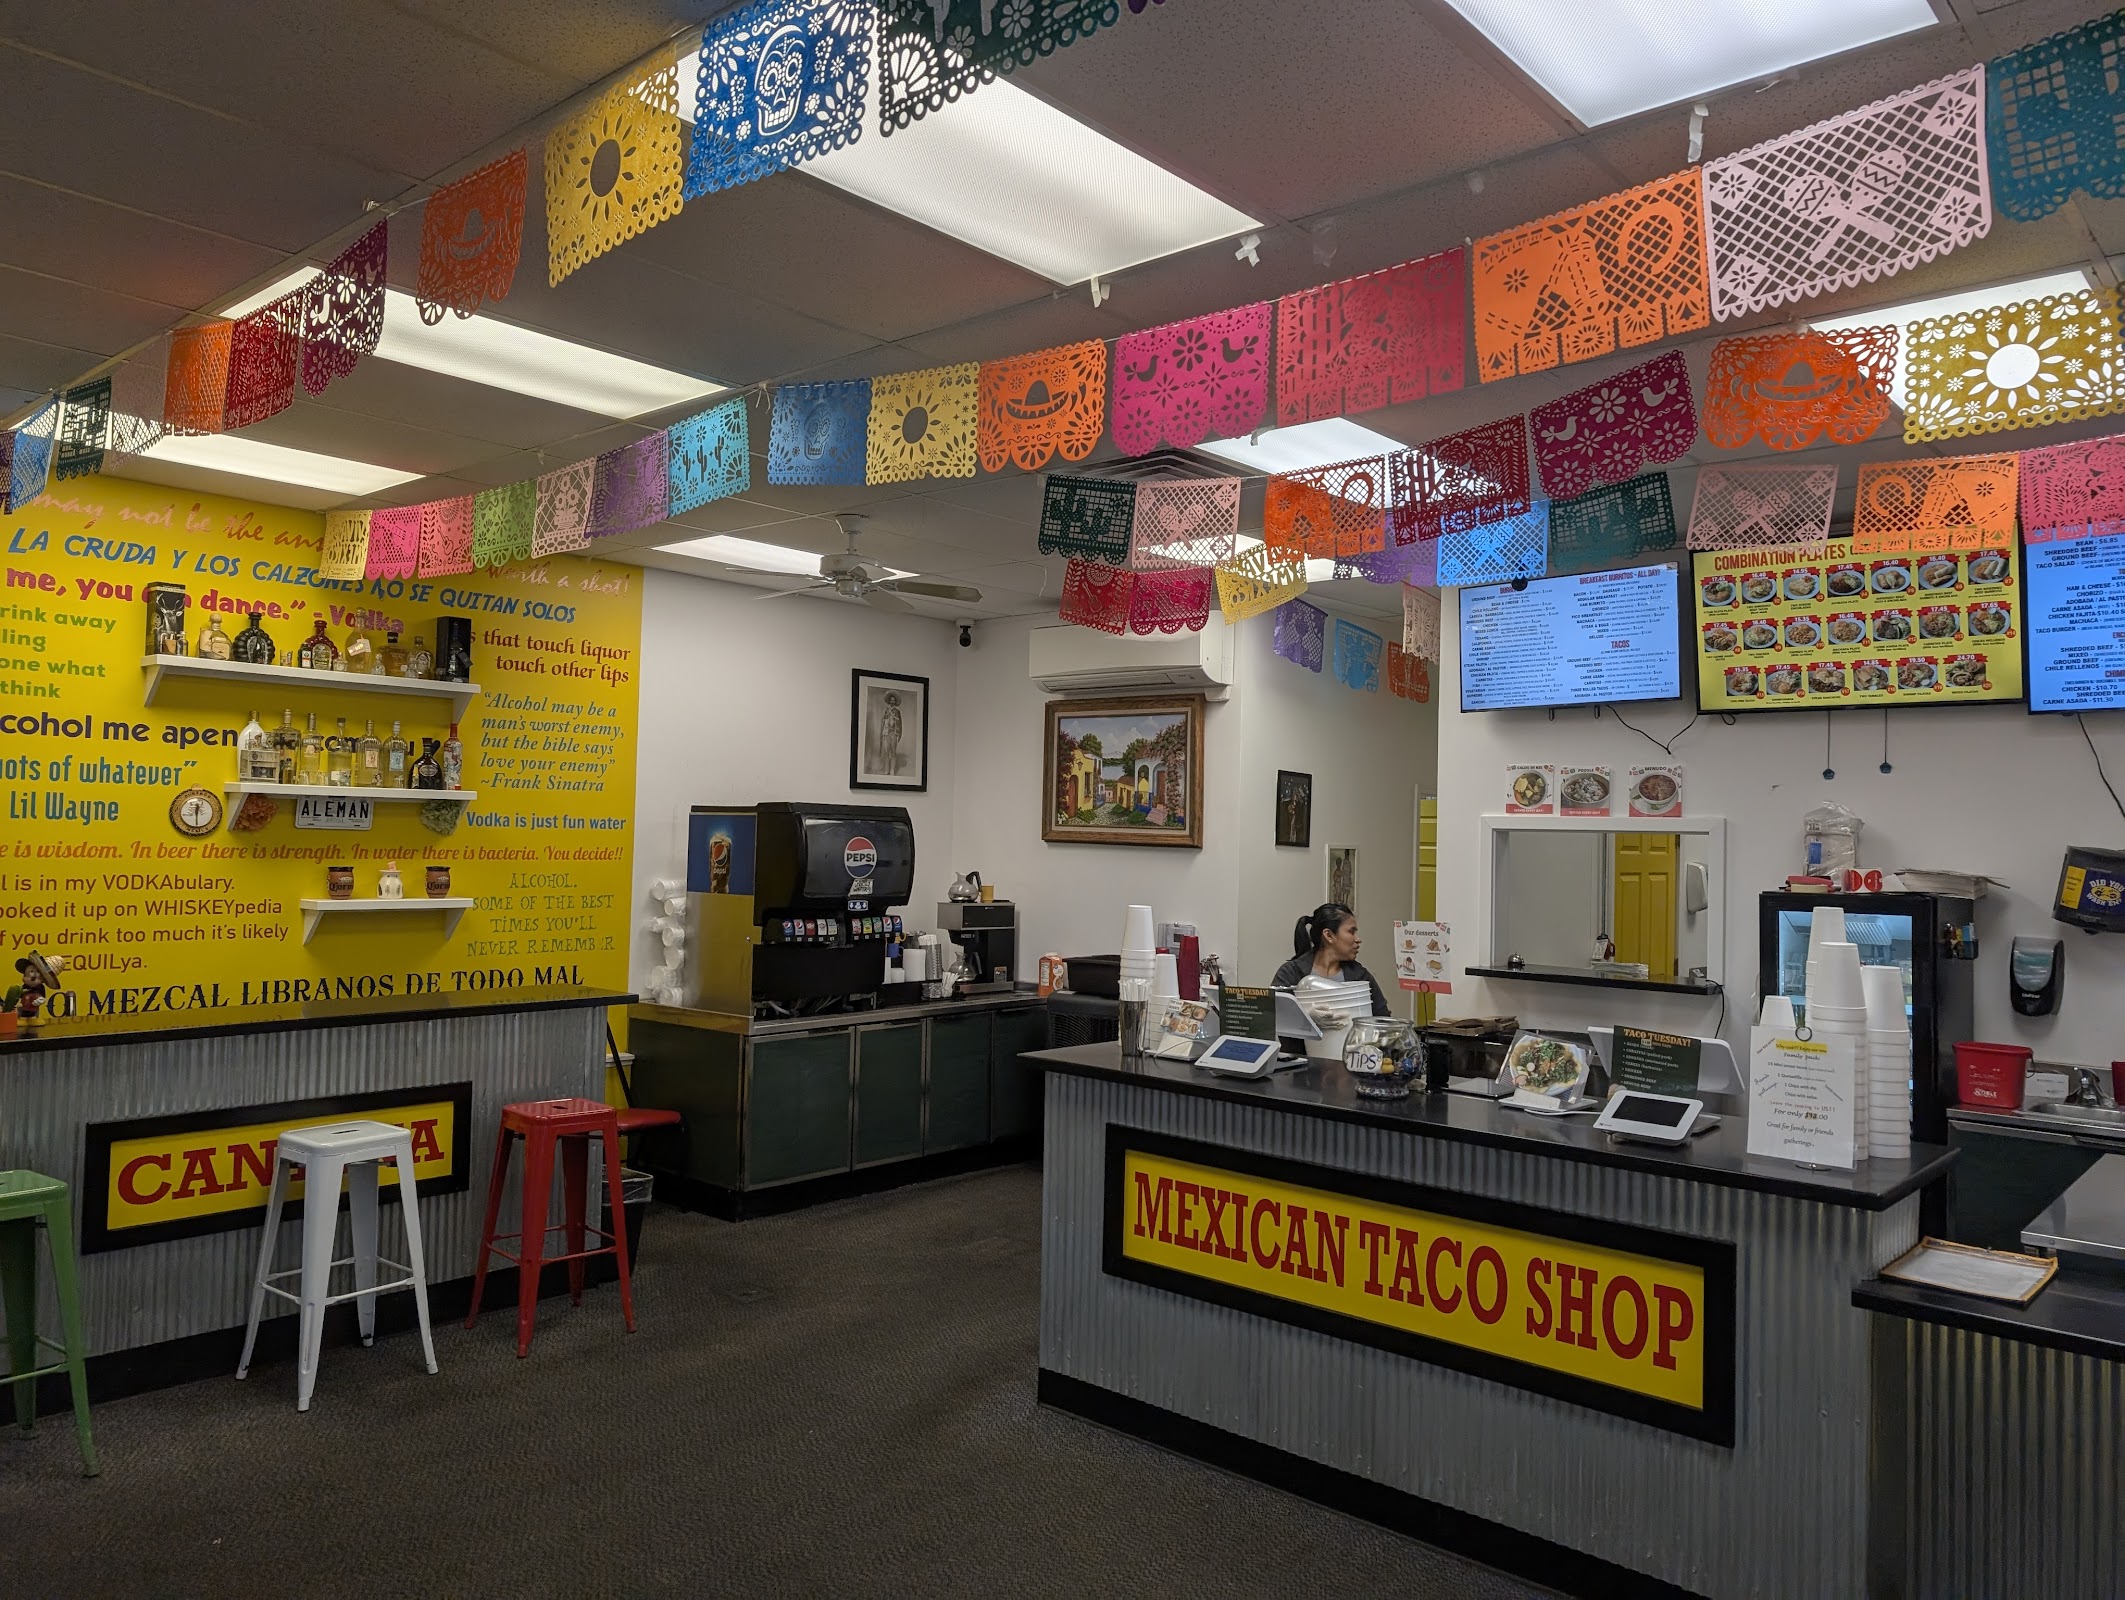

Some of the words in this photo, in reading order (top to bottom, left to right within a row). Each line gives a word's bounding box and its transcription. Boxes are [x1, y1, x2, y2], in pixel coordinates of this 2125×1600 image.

[118, 503, 176, 528] not
[185, 503, 213, 533] be
[221, 512, 264, 541] the
[1714, 551, 1795, 571] COMBINATION
[1799, 544, 1845, 562] PLATES
[2044, 547, 2079, 556] SHREDDED
[2051, 553, 2080, 561] GROUND
[2054, 560, 2076, 568] SALAD
[6, 567, 67, 596] me,
[75, 577, 134, 601] you
[8, 528, 49, 554] LA
[64, 535, 156, 565] CRUDA
[172, 549, 188, 569] Y
[194, 553, 241, 576] LOS
[369, 577, 404, 600] NO
[409, 583, 434, 602] SE
[439, 588, 521, 615] QUITAN
[523, 601, 577, 623] SOLOS
[556, 575, 571, 588] a
[1579, 574, 1608, 585] BREAKFAST
[1608, 572, 1634, 581] BURRITOS
[1637, 570, 1647, 578] ALL
[0, 604, 48, 623] rink
[53, 612, 117, 633] away
[1930, 605, 1948, 613] 17.45
[2, 628, 47, 652] ling
[483, 629, 521, 648] that
[526, 636, 575, 654] touch
[580, 639, 631, 664] liquor
[1610, 640, 1630, 649] TACOS
[0, 657, 41, 672] one
[47, 659, 106, 677] what
[1908, 656, 1925, 664] 19.50
[495, 655, 548, 674] touch
[551, 661, 596, 680] other
[600, 664, 629, 688] lips
[0, 680, 61, 699] think
[551, 703, 584, 719] may
[588, 702, 605, 717] be
[608, 706, 617, 717] a
[0, 711, 92, 739] cohol
[102, 720, 151, 742] me
[529, 720, 571, 734] worst
[573, 724, 625, 740] enemy,
[480, 732, 510, 750] but
[513, 734, 539, 750] the
[543, 736, 580, 753] bible
[583, 743, 614, 759] says
[0, 755, 41, 781] ots
[49, 754, 73, 782] of
[480, 752, 515, 769] love
[520, 758, 556, 774] your
[545, 774, 605, 792] Sinatra
[10, 790, 37, 820] Lil
[45, 791, 120, 826] Wayne
[466, 811, 510, 828] Vodka
[514, 812, 527, 828] is
[530, 812, 559, 831] just
[562, 813, 586, 829] fun
[589, 815, 627, 830] water
[14, 840, 32, 858] is
[36, 840, 123, 859] wisdom.
[130, 840, 152, 859] In
[156, 842, 198, 860] beer
[200, 843, 248, 860] there
[252, 844, 267, 860] is
[269, 844, 346, 864] strength.
[352, 843, 369, 860] In
[372, 844, 419, 860] water
[421, 843, 460, 860] there
[462, 846, 476, 861] is
[478, 846, 539, 861] bacteria.
[544, 845, 571, 861] You
[573, 846, 624, 861] decide!!
[846, 853, 875, 862] PEPSI
[14, 874, 32, 891] is
[39, 874, 57, 891] in
[66, 878, 97, 894] my
[103, 873, 235, 893] VODKAbulary.
[508, 872, 578, 889] ALCOHOL.
[2089, 879, 2107, 888] DID
[2109, 880, 2125, 893] YOU
[0, 902, 57, 918] oked
[64, 901, 76, 918] it
[83, 904, 108, 921] up
[114, 904, 138, 917] on
[144, 898, 282, 918] WHISKEYpedia
[471, 895, 514, 912] SOME
[519, 894, 538, 911] OF
[544, 894, 575, 910] THE
[581, 893, 615, 910] BEST
[11, 932, 49, 950] you
[57, 927, 110, 945] drink
[117, 928, 146, 943] too
[152, 924, 206, 942] much
[242, 923, 289, 943] likely
[466, 939, 518, 957] NEVER
[45, 953, 148, 973] EQUILya.
[87, 982, 230, 1016] MEZCAL
[240, 974, 394, 1006] LIBRANOS
[405, 972, 441, 997] DE
[451, 967, 525, 991] TODO
[534, 964, 585, 988] MAL
[1624, 1028, 1646, 1039] TACO
[1647, 1032, 1691, 1047] TUESDAY!
[1787, 1110, 1803, 1119] only
[117, 1118, 445, 1206] CANA
[1133, 1171, 1350, 1288] MEXICAN
[1358, 1218, 1509, 1326] TACO
[1524, 1256, 1694, 1372] SHOP
